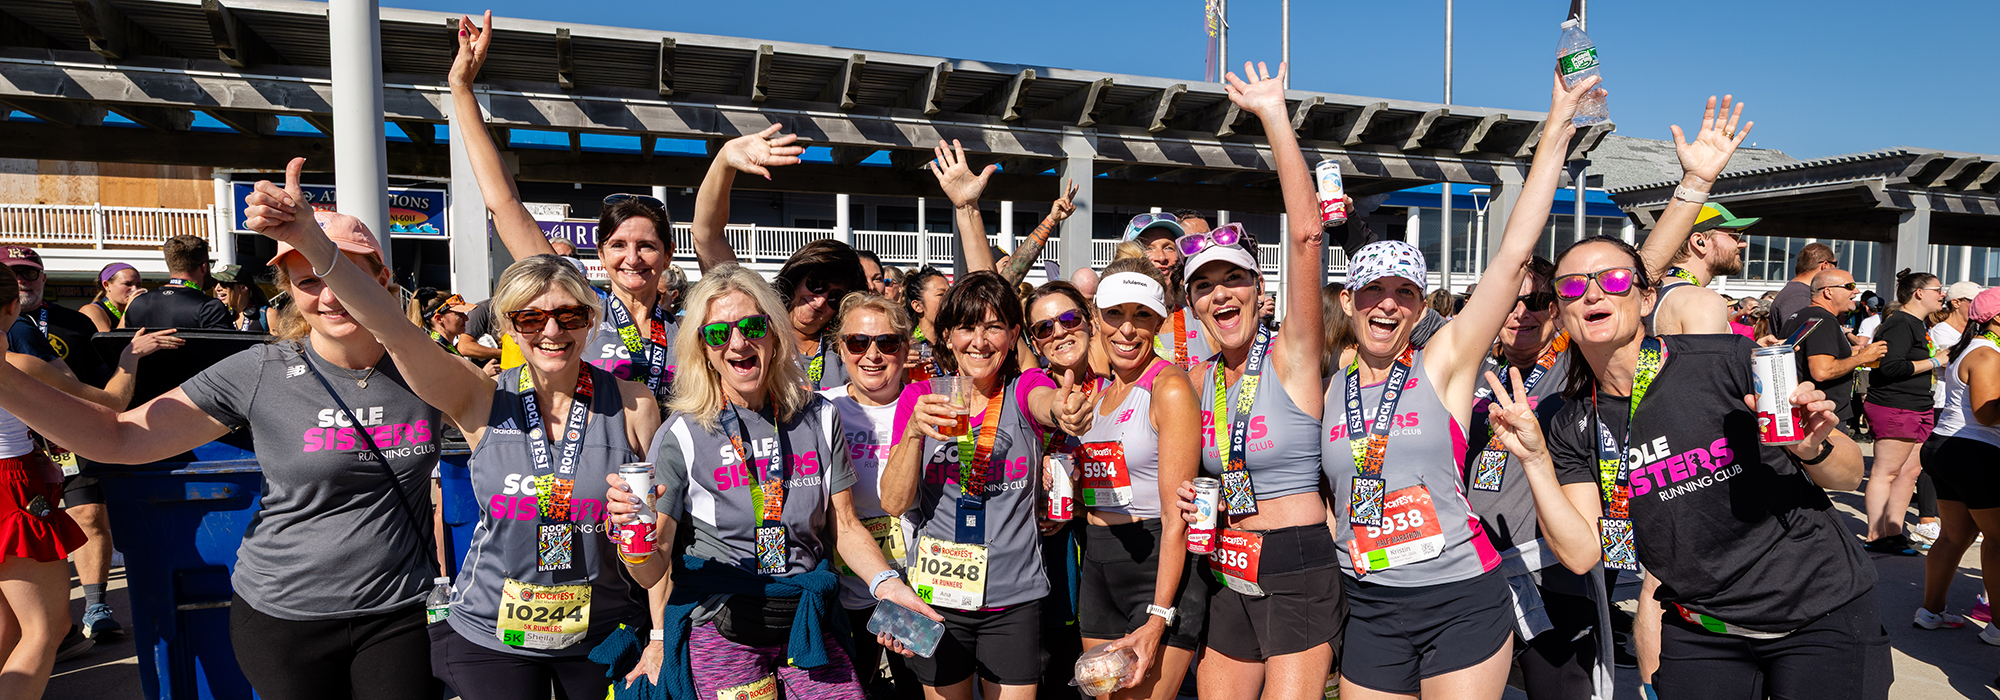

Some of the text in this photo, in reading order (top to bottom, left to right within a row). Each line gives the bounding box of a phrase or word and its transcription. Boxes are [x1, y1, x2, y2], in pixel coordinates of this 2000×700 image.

[389, 214, 416, 223] NI-GOLF
[1123, 279, 1147, 288] lululemon
[615, 305, 630, 324] FEST
[652, 345, 663, 366] FEST
[1248, 343, 1264, 371] ROCK
[1349, 374, 1364, 433] ROCK FEST
[1375, 366, 1405, 430] ROCK FEST
[318, 406, 384, 428] SOLE
[302, 419, 432, 453] SISTERS
[524, 394, 549, 469] ROCK FEST
[1329, 412, 1420, 442] SITRS
[559, 400, 585, 475] ROCK FEST
[844, 430, 889, 444] SOLE
[1233, 421, 1245, 452] 2025
[358, 443, 436, 462] RUNNING CLUB
[720, 438, 773, 465] SOLE
[1248, 440, 1274, 453] CLUB
[1628, 435, 1672, 470] OLE
[713, 451, 819, 491] SISTRS
[925, 456, 1028, 485] SISERS
[1084, 461, 1117, 478] 5934
[1617, 445, 1628, 480] ROCK
[1628, 437, 1734, 499] ISTERS
[803, 476, 821, 486] CLUB
[1223, 471, 1245, 480] ROCK
[1356, 478, 1380, 487] ROCK
[1658, 463, 1743, 502] RUNNING CLUB
[983, 482, 1009, 492] NING
[490, 494, 609, 524] SISER
[1383, 495, 1414, 509] OCKFEST
[542, 524, 567, 533] ROCK
[759, 526, 780, 535] ROCK
[1366, 509, 1424, 538] 5938
[1603, 519, 1628, 528] ROCK
[1603, 527, 1624, 536] FEST
[541, 532, 562, 542] FEST
[1376, 530, 1423, 548] HALF MARATHON
[942, 547, 973, 558] ROCKFEST
[1210, 548, 1248, 570] 5936
[1390, 546, 1412, 555] Kristin
[921, 557, 980, 582] 10248
[939, 579, 963, 589] RUNNERS
[535, 592, 575, 600] ROCKFEST
[917, 588, 931, 600] 5K
[506, 603, 583, 622] 10244
[533, 624, 563, 632] RUNNERS
[504, 633, 554, 643] 5K Sheila
[749, 682, 776, 699] ROCKFEST
